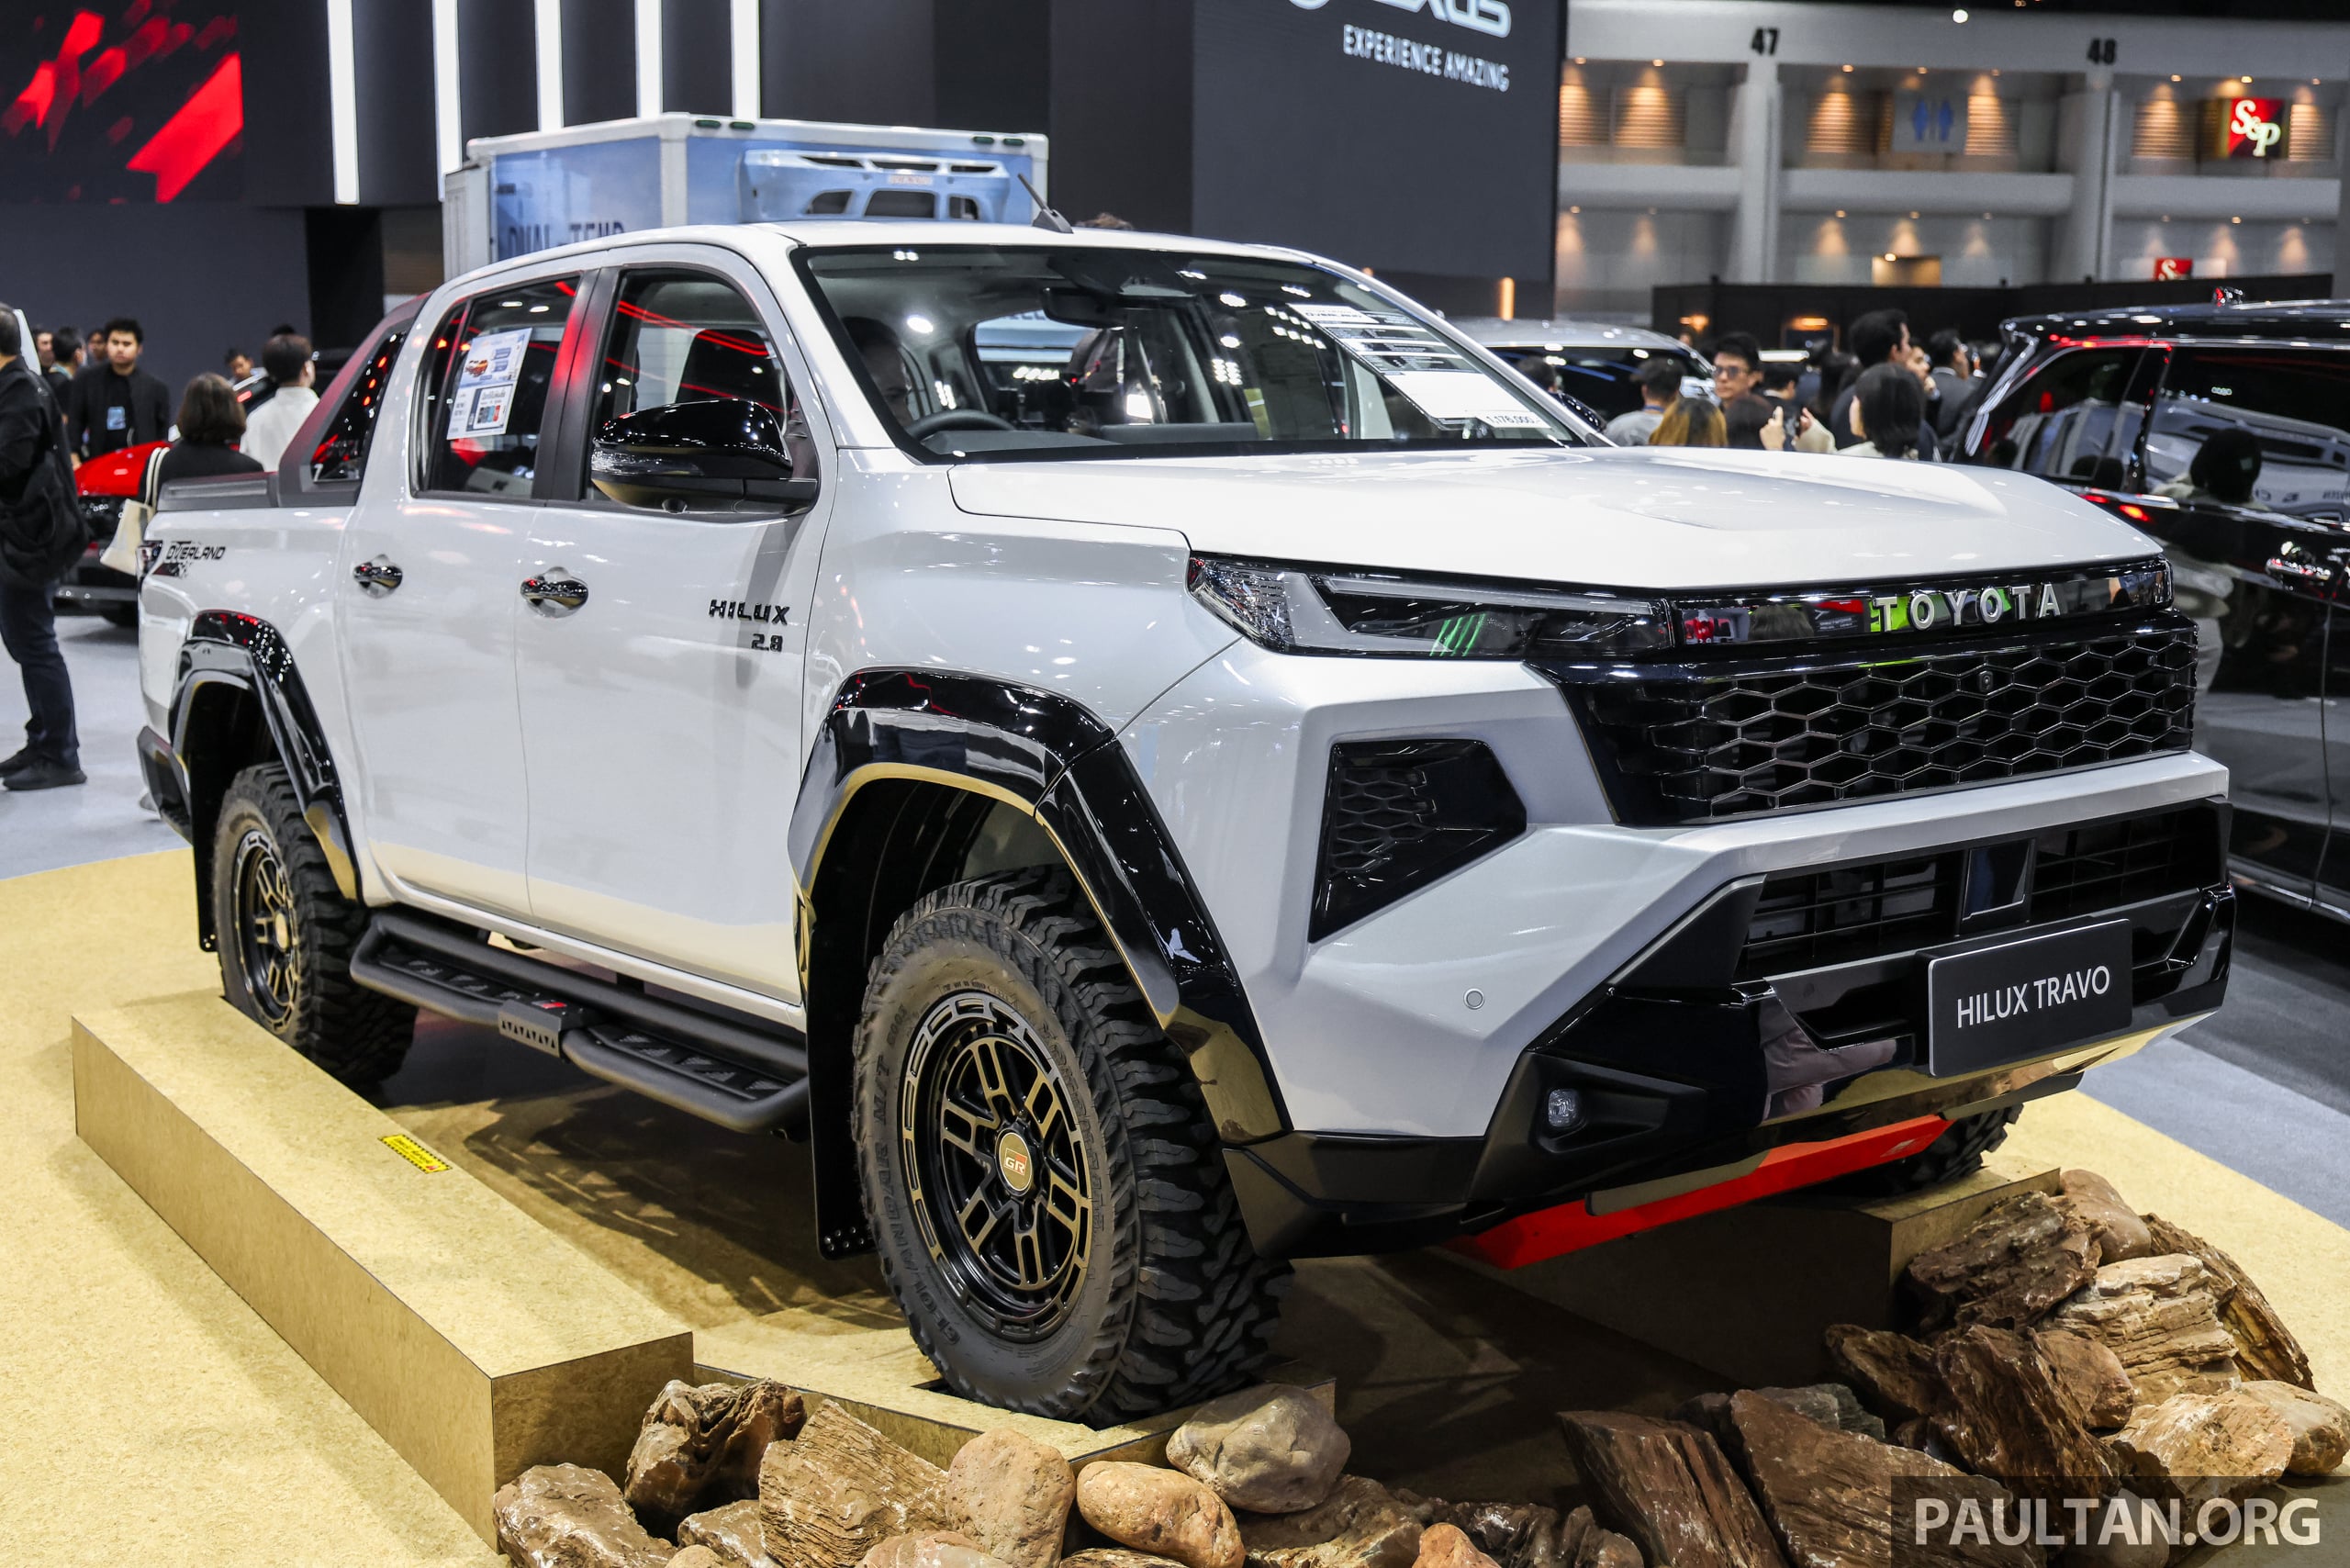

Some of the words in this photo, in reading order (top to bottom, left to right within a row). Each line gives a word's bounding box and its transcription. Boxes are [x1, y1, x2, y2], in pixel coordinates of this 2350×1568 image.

[1751, 28, 1778, 55] 47
[2087, 38, 2117, 64] 48
[1343, 24, 1442, 75] EXPERIENCE
[1443, 50, 1510, 92] AMAZING
[166, 545, 227, 561] OVERLAND
[709, 599, 790, 626] HILUX
[1874, 581, 2061, 633] TOYOTA
[751, 633, 783, 653] 2.8
[1957, 983, 2029, 1028] HILUX
[2033, 965, 2110, 1009] TRAVO
[1005, 1157, 1025, 1174] GR
